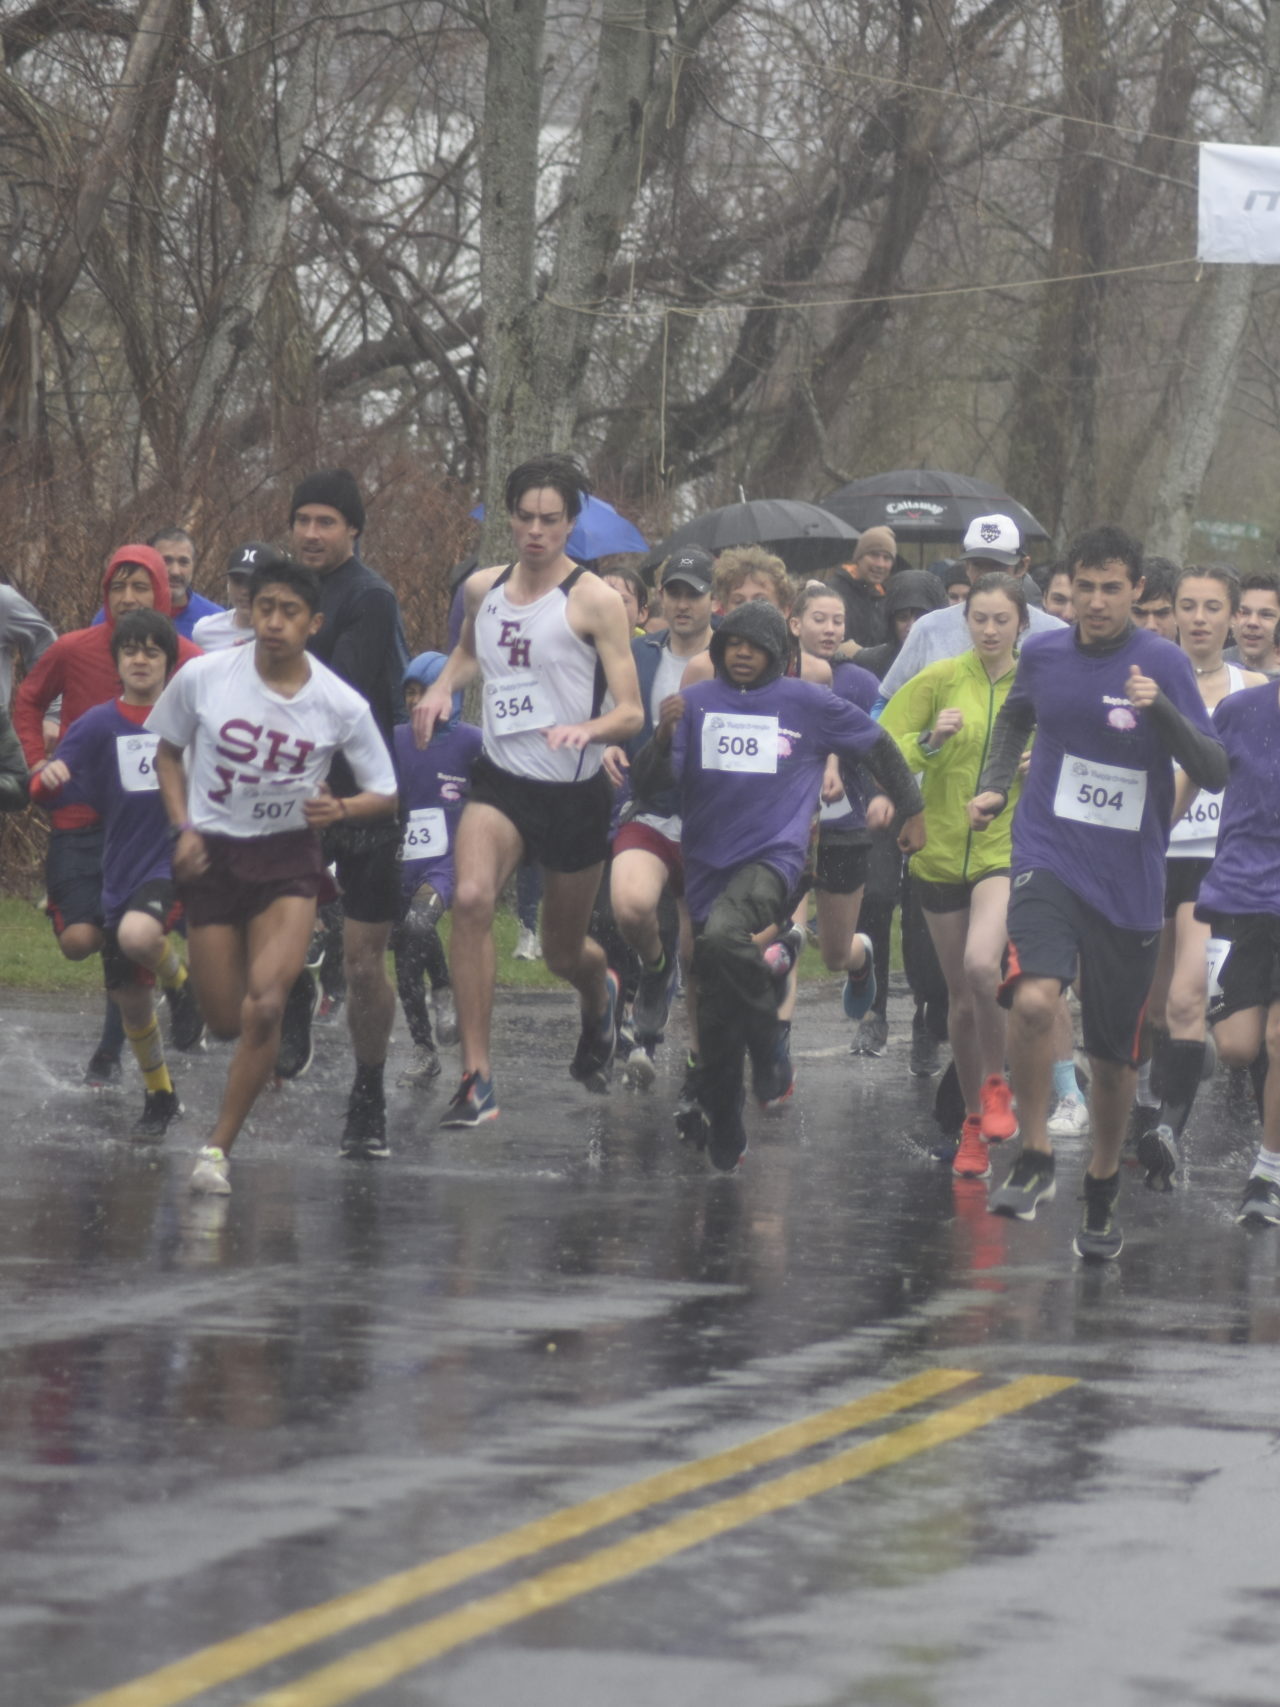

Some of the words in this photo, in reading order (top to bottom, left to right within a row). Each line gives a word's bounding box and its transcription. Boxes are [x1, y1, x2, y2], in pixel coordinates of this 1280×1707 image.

[886, 501, 943, 515] Callaway
[494, 695, 534, 719] 354
[215, 718, 316, 775] SH
[717, 735, 758, 756] 508
[1077, 783, 1124, 811] 504
[251, 799, 298, 819] 507
[405, 827, 432, 846] 63
